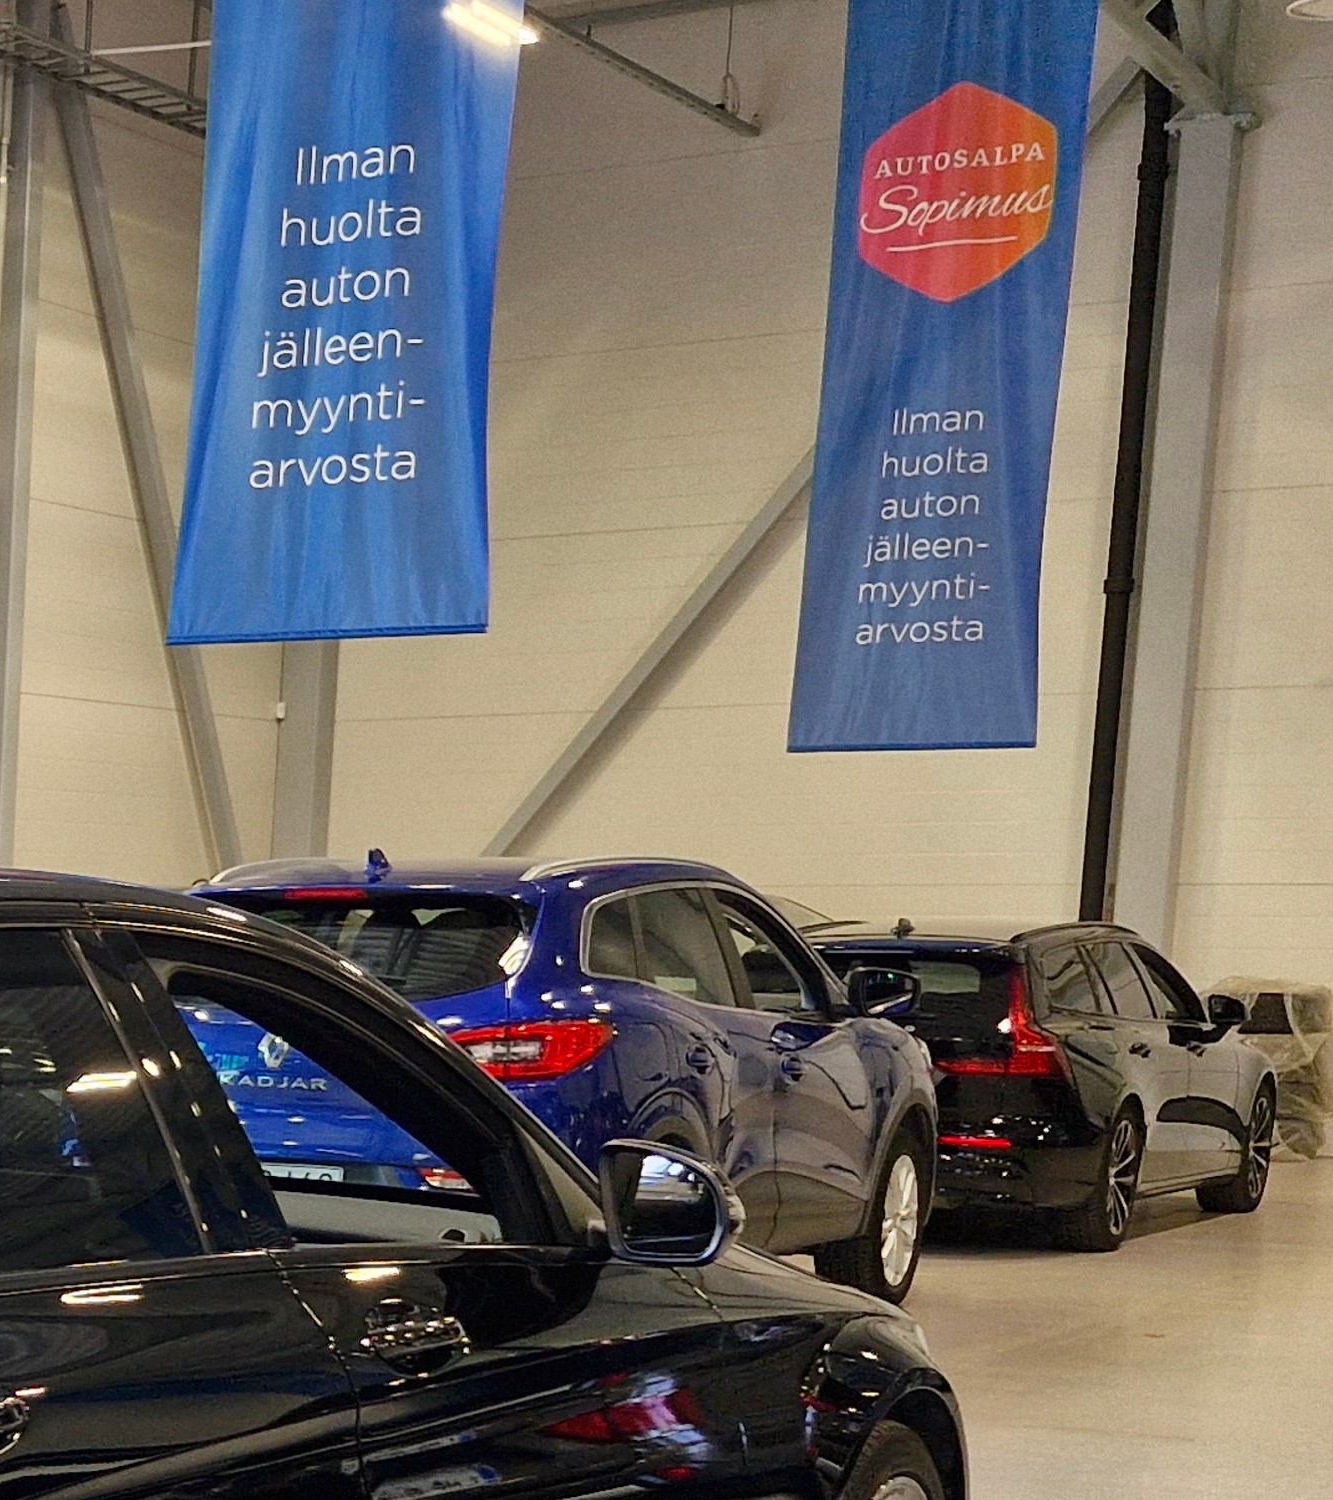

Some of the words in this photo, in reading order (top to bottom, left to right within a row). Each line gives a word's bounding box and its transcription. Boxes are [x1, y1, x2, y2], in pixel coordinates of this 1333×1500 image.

[296, 143, 415, 186] Ilman
[874, 142, 1045, 179] AUTOSALPA
[280, 198, 422, 247] huolta
[860, 184, 1054, 236] Sopimus
[281, 266, 410, 308] auton
[257, 326, 424, 378] jälleen-
[251, 380, 426, 436] myynti-
[893, 407, 984, 436] Ilman
[249, 443, 416, 489] arvosta
[881, 446, 988, 478] huolta
[880, 491, 980, 520] auton
[863, 532, 989, 565] jälleen-
[858, 573, 991, 608] myynti-
[855, 615, 984, 645] arvosta
[217, 1072, 328, 1091] KADJAR
